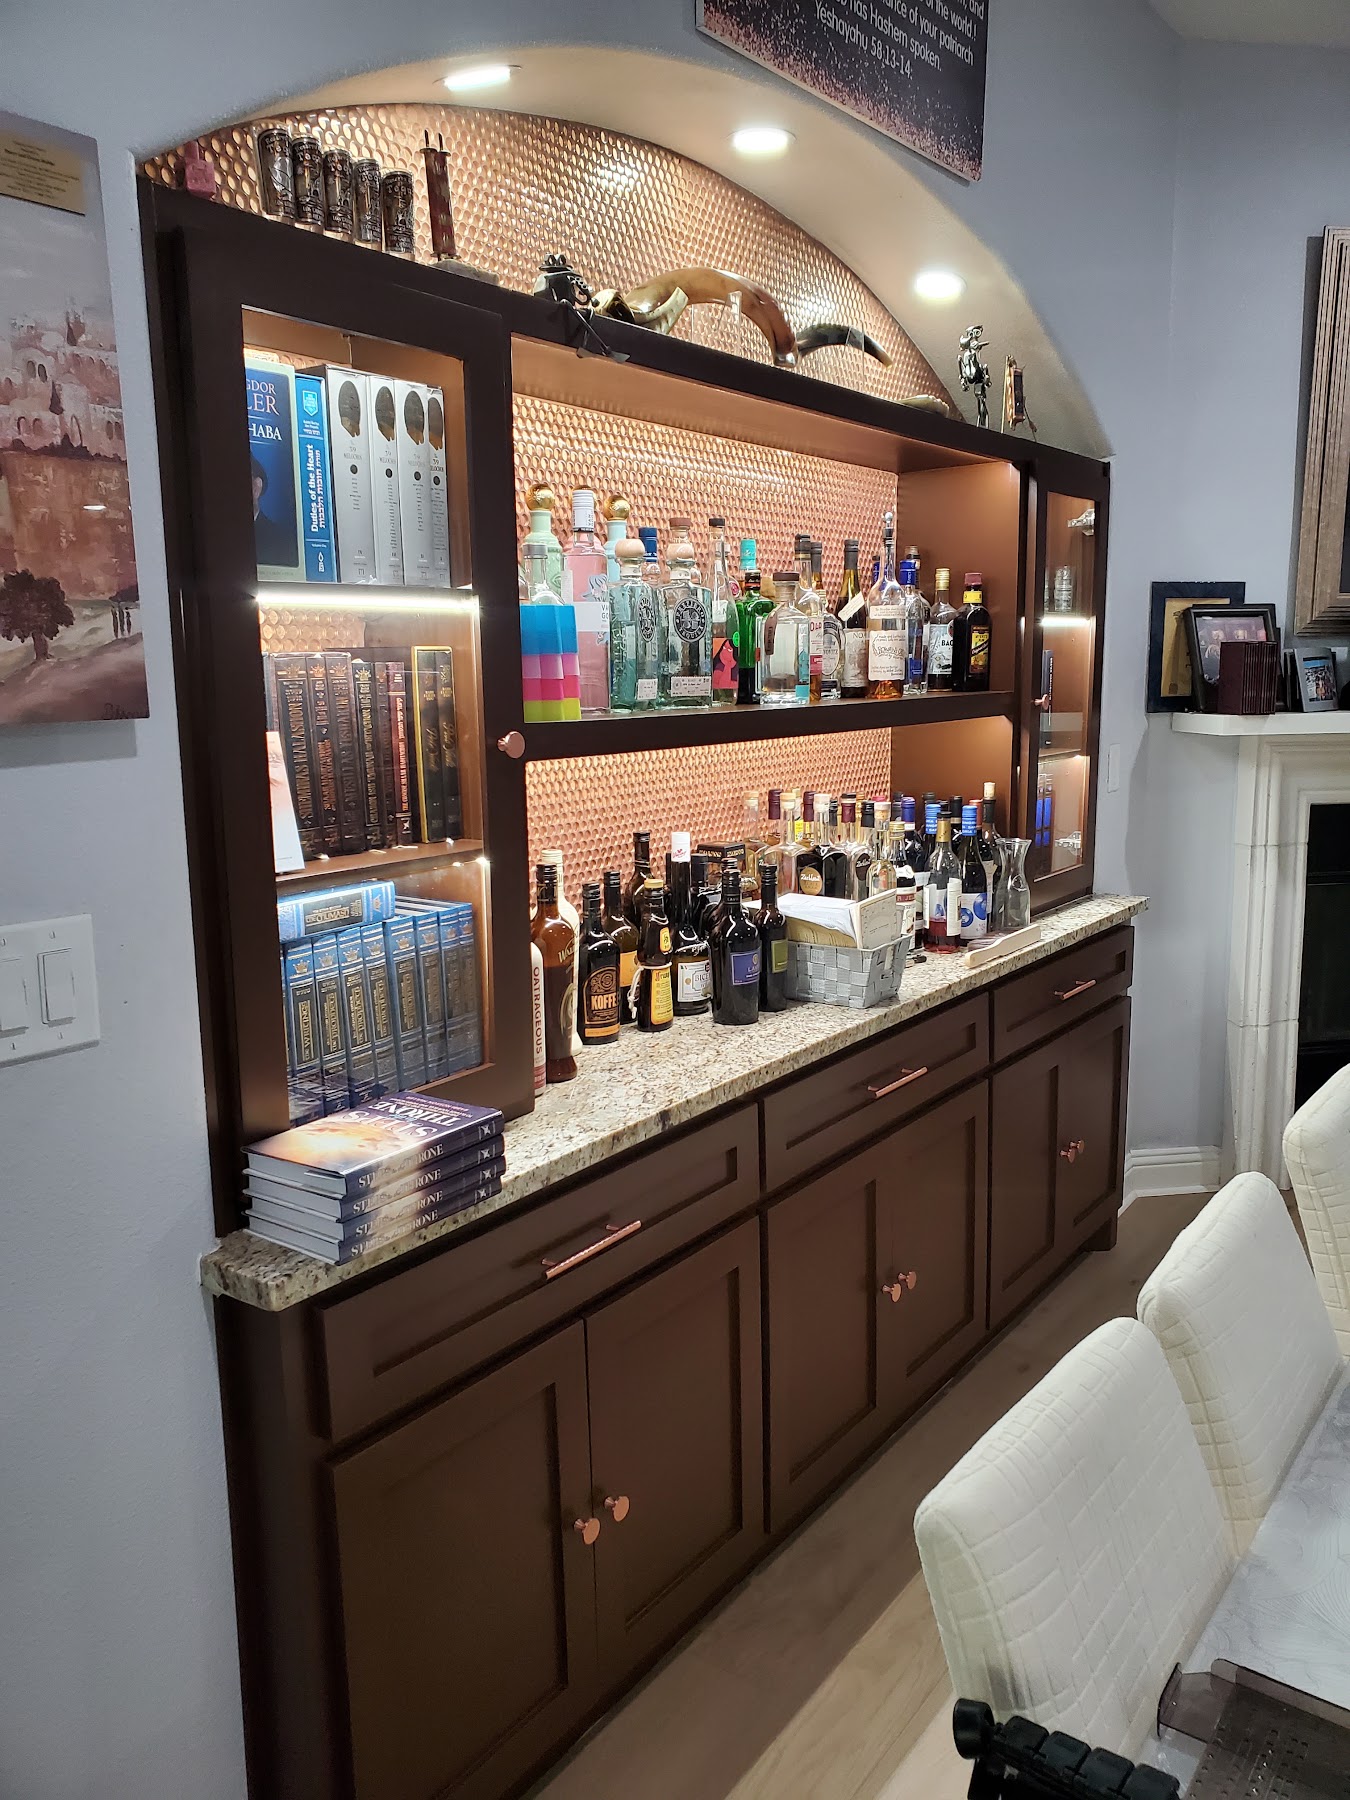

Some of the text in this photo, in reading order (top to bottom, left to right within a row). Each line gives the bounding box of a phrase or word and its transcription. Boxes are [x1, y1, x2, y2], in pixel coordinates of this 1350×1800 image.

[814, 1, 868, 50] Yeshayahu
[850, 0, 942, 72] has Hashem spoken.
[909, 6, 918, 26] of
[919, 15, 938, 40] your
[940, 29, 974, 66] patriarch
[247, 392, 280, 416] ER
[306, 444, 315, 471] Heart
[308, 489, 317, 501] of
[310, 502, 319, 532] Duties
[532, 966, 544, 1054] OATRAGEOUS
[342, 1110, 438, 1138] STEPS
[368, 1101, 462, 1126] THRONE
